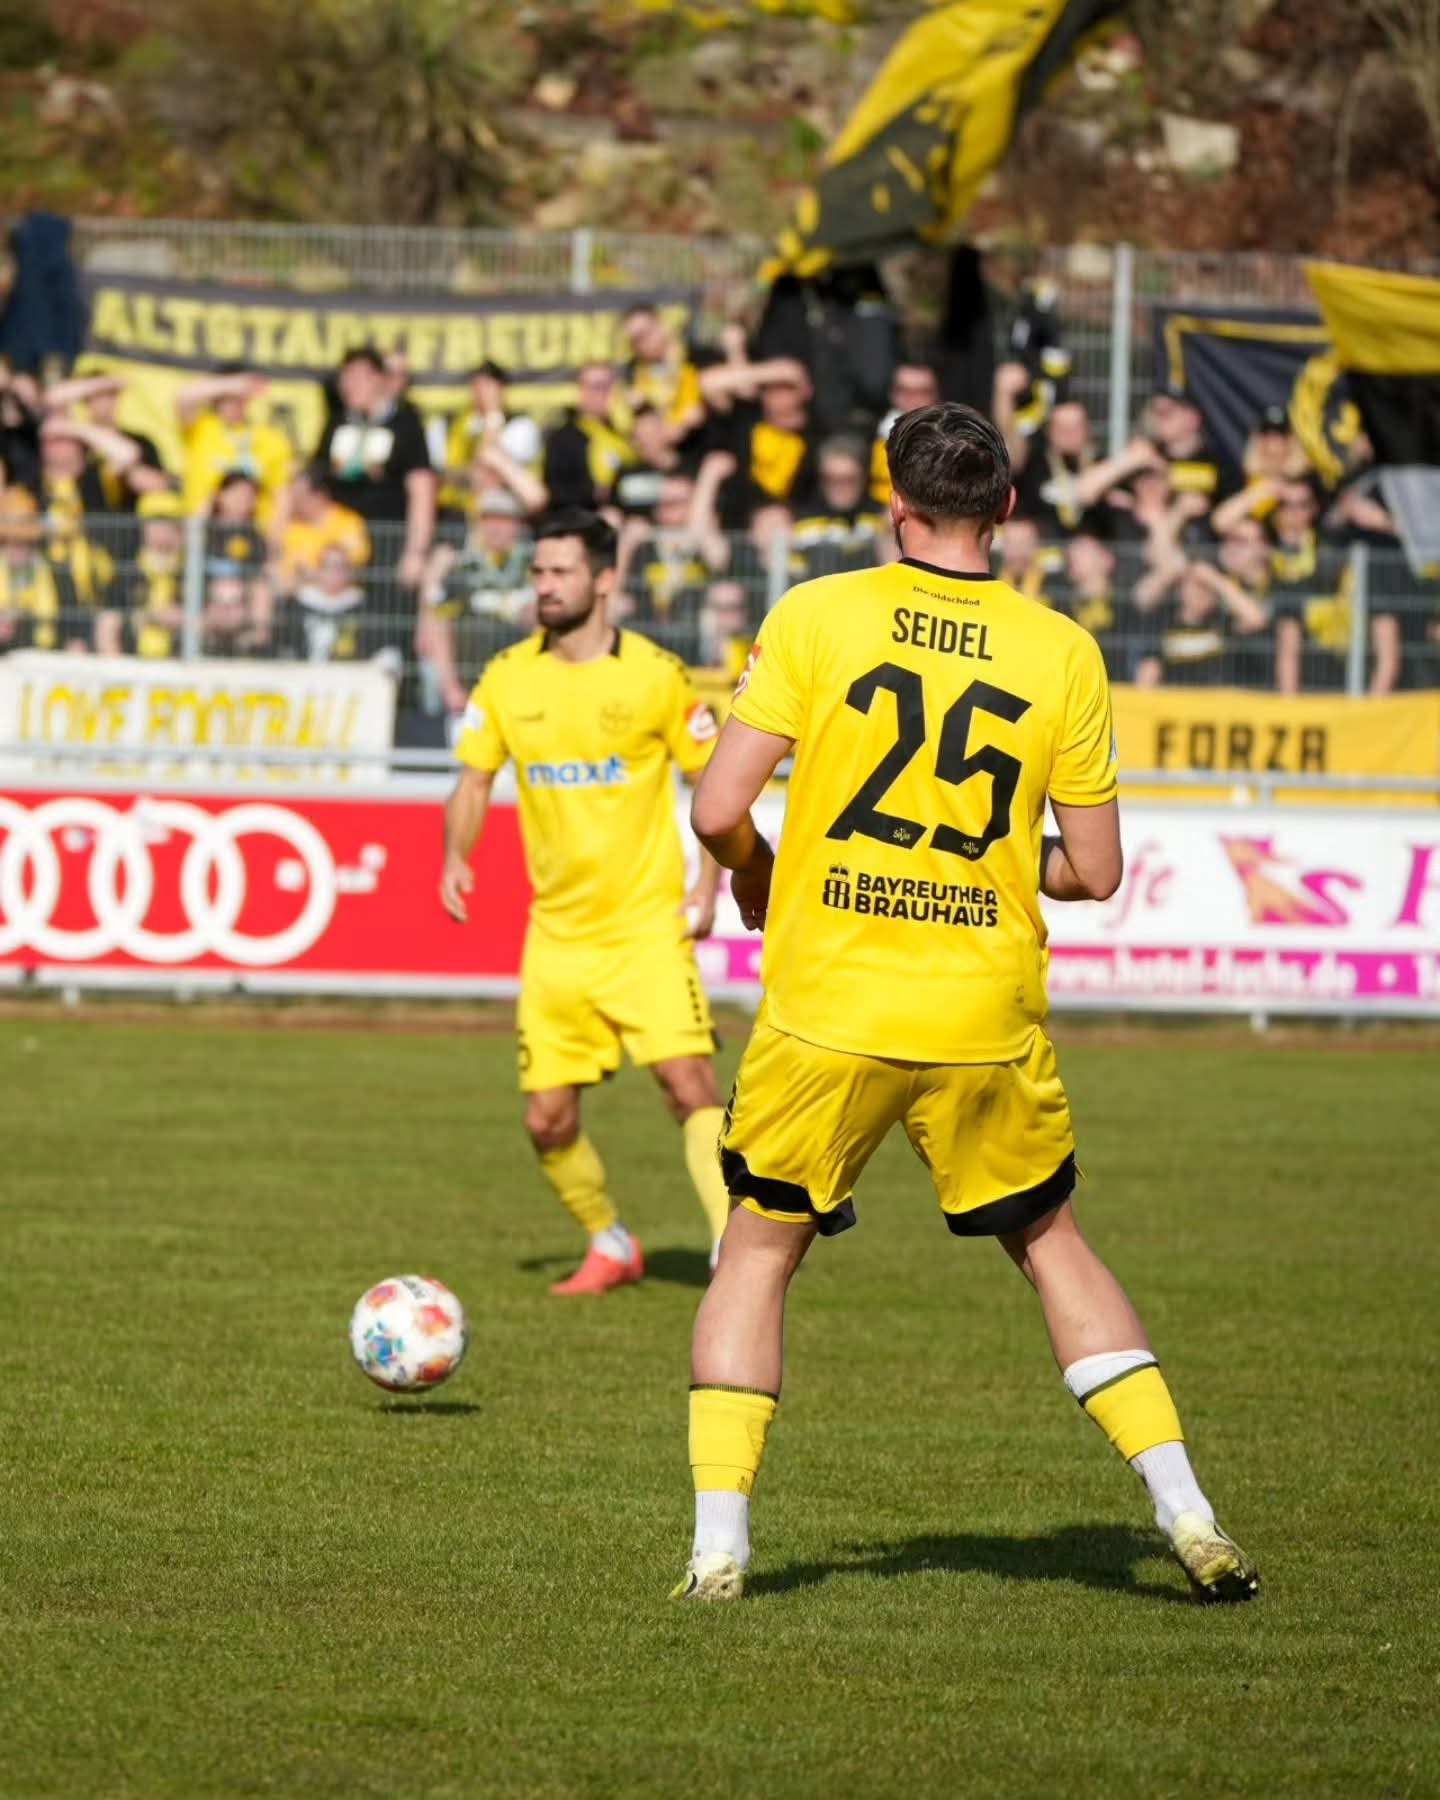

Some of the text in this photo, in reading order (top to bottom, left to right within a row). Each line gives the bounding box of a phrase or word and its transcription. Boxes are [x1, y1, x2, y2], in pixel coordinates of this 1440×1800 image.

[891, 607, 993, 661] SEIDEL
[825, 661, 1032, 862] 25
[1153, 720, 1328, 773] FORZA
[526, 756, 625, 786] maxit
[854, 892, 998, 928] BRAUHAUS
[856, 872, 998, 906] BAYREUTHER
